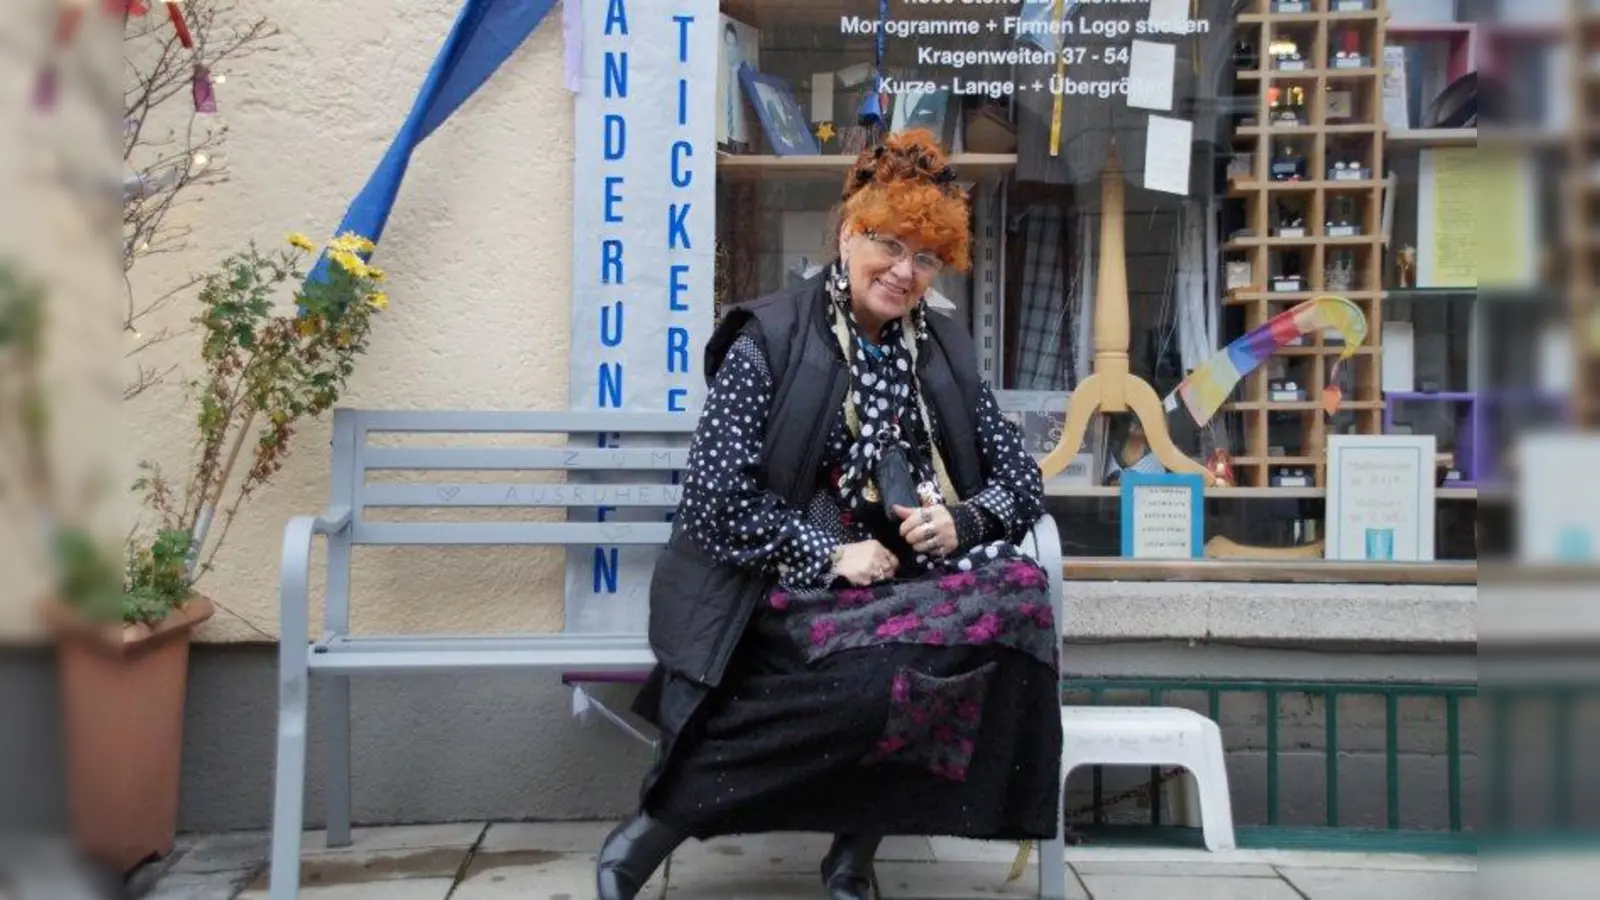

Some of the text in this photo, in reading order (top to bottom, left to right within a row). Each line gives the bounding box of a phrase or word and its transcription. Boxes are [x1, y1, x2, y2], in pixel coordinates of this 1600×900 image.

[1004, 16, 1073, 34] Firmen
[1079, 17, 1130, 38] Logo
[1135, 18, 1209, 34] stien
[918, 47, 1056, 68] Kragenweiten
[1062, 48, 1087, 64] 37
[1104, 47, 1129, 64] 54
[879, 77, 936, 94] Kurze
[953, 77, 1014, 98] Lange
[1048, 73, 1169, 98] Übergrö
[504, 486, 681, 502] AUSRUHEN
